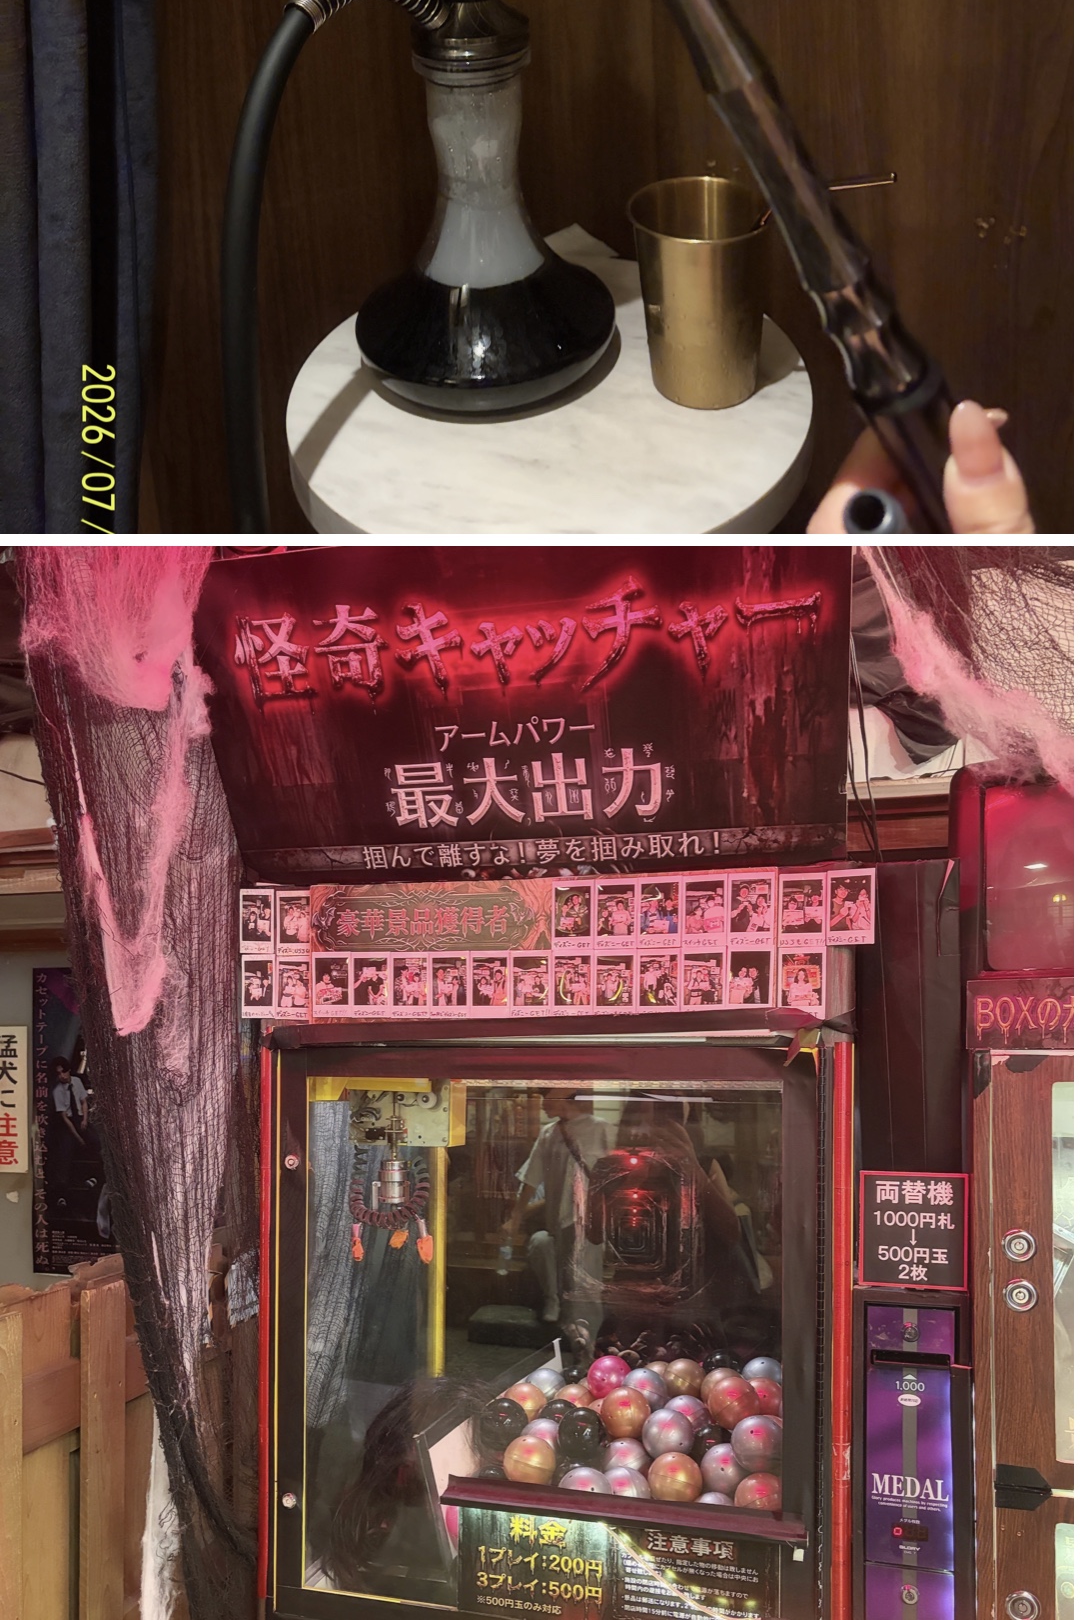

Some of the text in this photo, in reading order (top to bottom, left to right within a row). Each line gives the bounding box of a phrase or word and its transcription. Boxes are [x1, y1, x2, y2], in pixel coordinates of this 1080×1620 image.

[234, 577, 822, 706] 怪奇キャッチャー
[433, 715, 597, 752] アームパワー
[390, 747, 662, 830] 最大出力
[336, 905, 511, 938] 豪華景品獲得者
[875, 1179, 954, 1207] 両替機
[872, 1210, 956, 1231] 1000円札
[877, 1245, 949, 1265] 500円玉
[897, 1264, 928, 1282] 2枚
[871, 1472, 950, 1502] MEDAL
[509, 1515, 568, 1547] 料金
[646, 1532, 735, 1561] 注意事項
